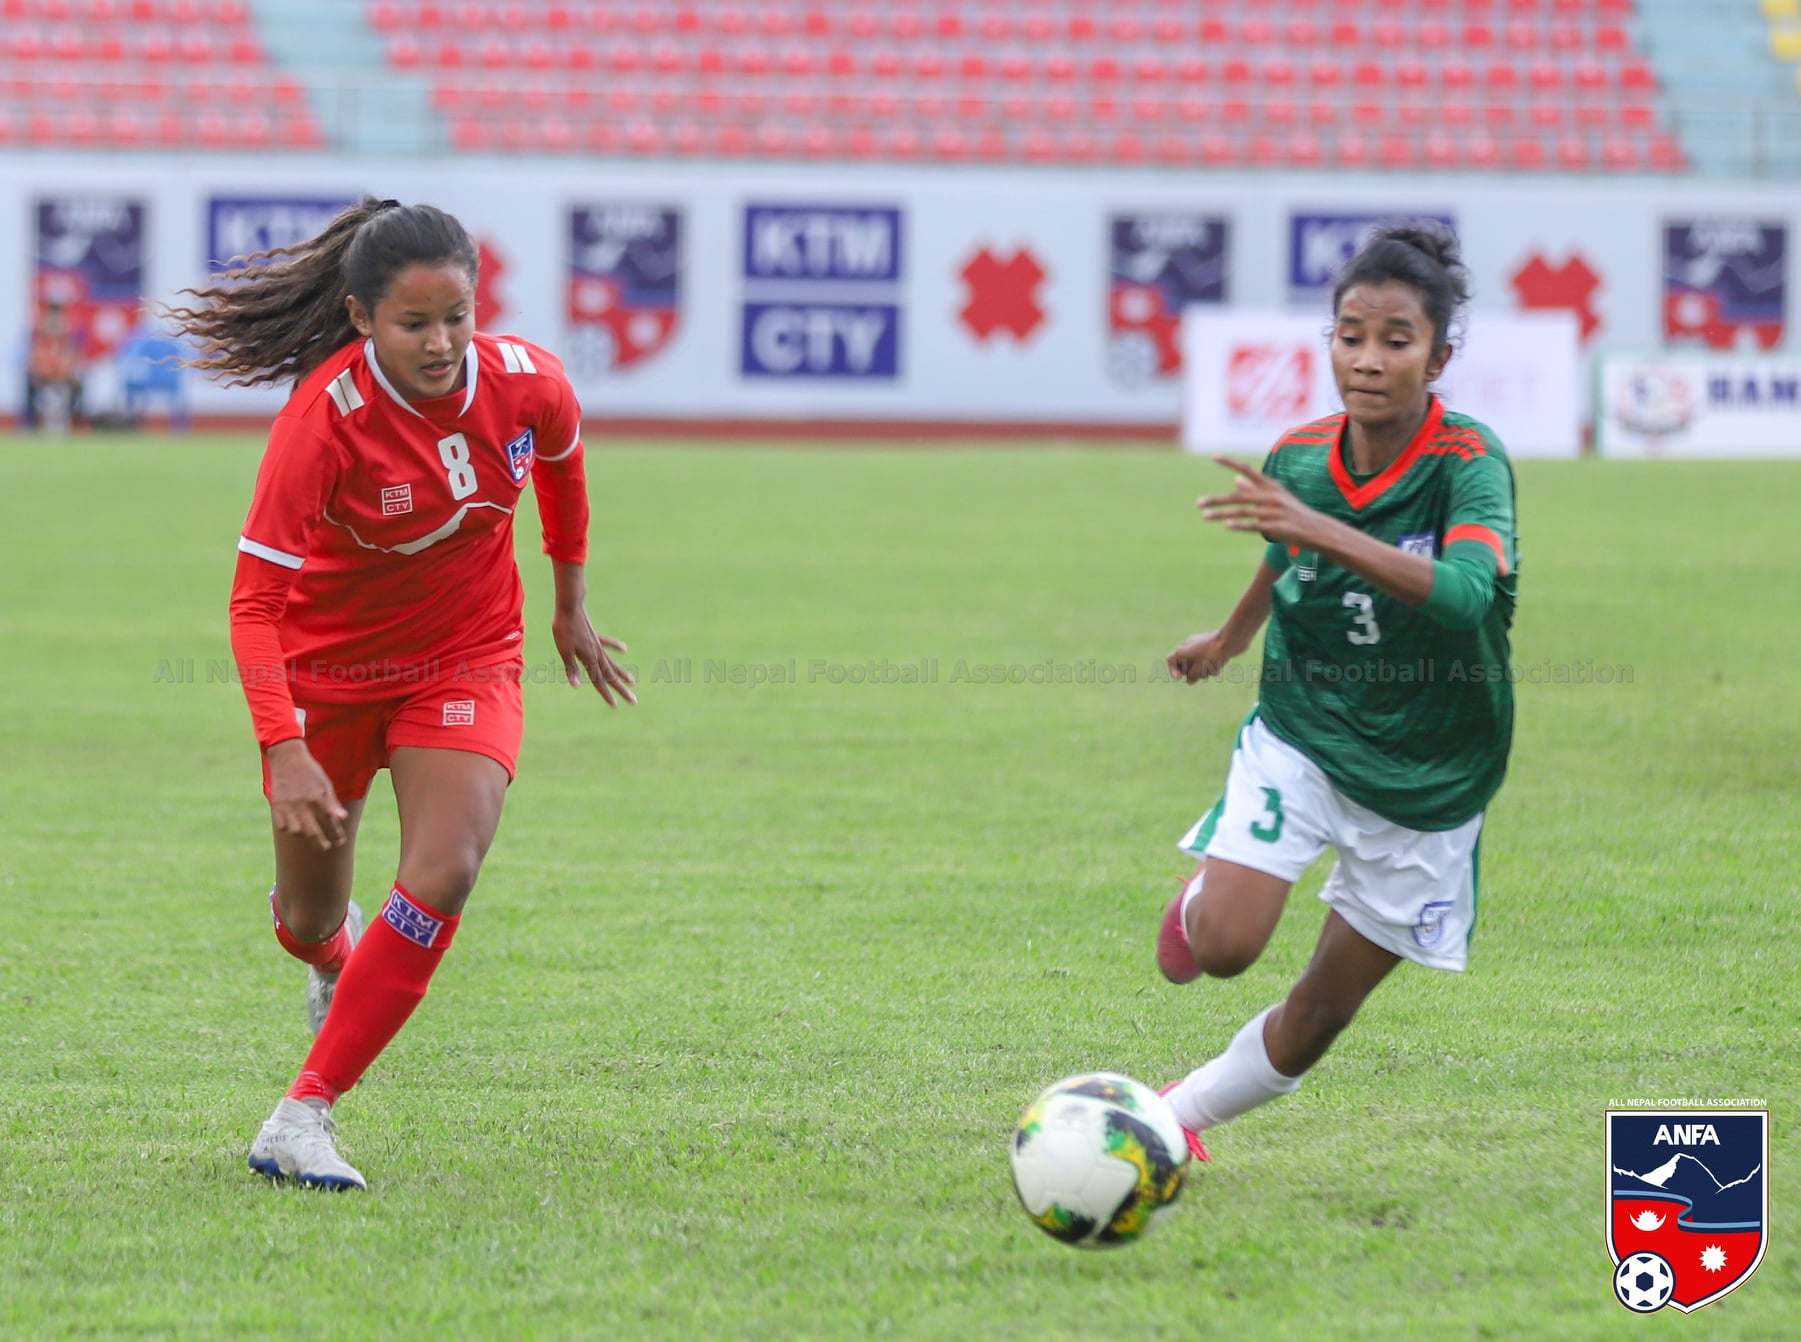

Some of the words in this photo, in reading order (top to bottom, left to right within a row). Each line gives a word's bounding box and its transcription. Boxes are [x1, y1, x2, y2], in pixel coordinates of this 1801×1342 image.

[752, 211, 892, 276] KTM
[752, 306, 887, 373] CTY
[437, 432, 479, 501] 8
[384, 488, 408, 498] KTM
[386, 501, 409, 511] CTY
[1342, 591, 1382, 645] 3
[446, 703, 471, 711] KTM
[447, 714, 470, 722] CTY
[1250, 786, 1285, 844] 3
[386, 909, 427, 939] CTY
[392, 894, 434, 930] KTM
